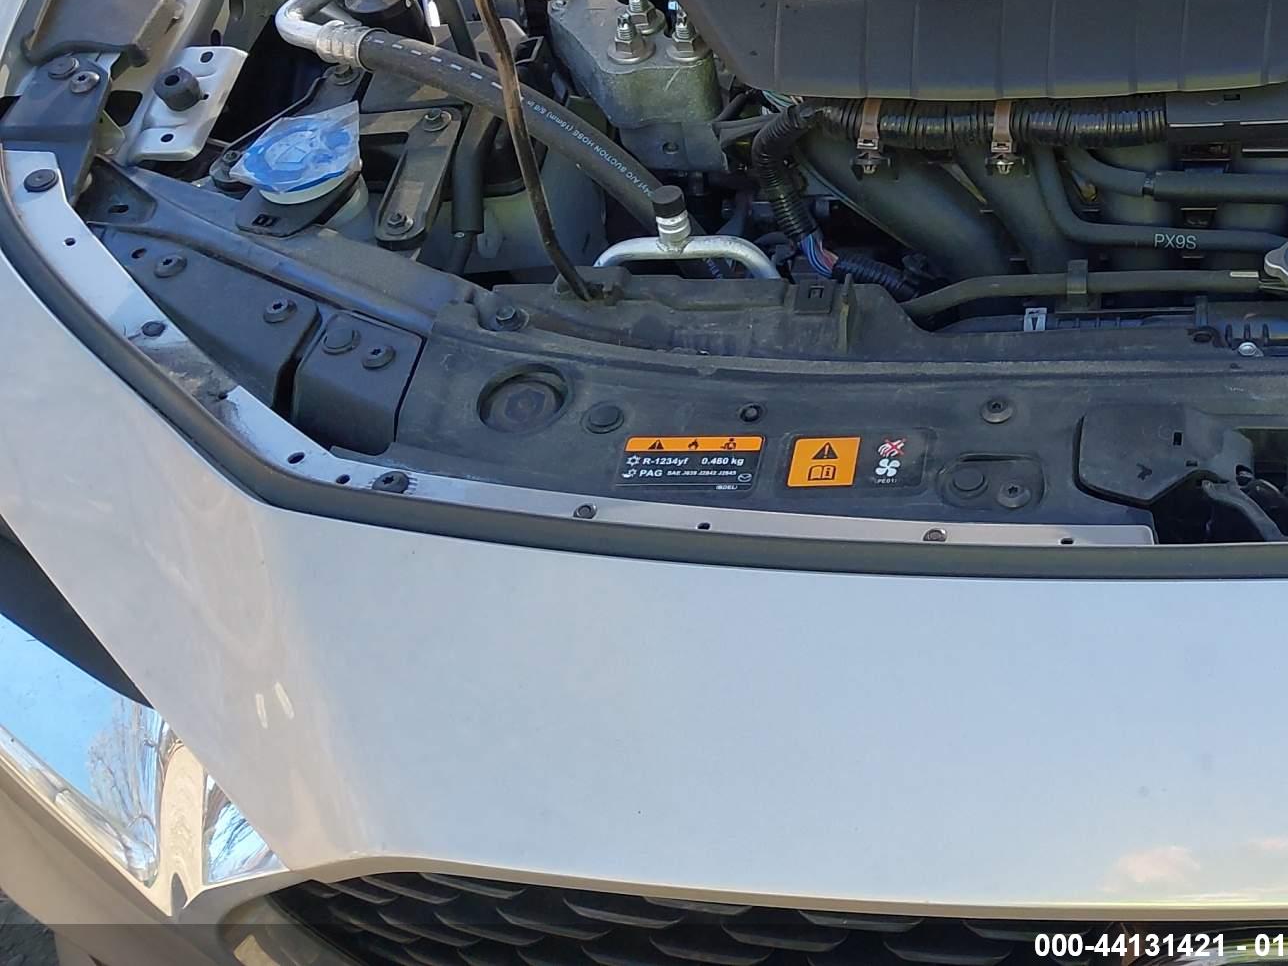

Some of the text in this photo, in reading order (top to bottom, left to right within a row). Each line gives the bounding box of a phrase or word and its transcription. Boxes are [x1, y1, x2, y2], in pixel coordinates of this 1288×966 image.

[1153, 233, 1197, 250] PX9S
[642, 457, 689, 467] R-1234yf
[730, 457, 745, 466] kg
[639, 469, 663, 477] PAG
